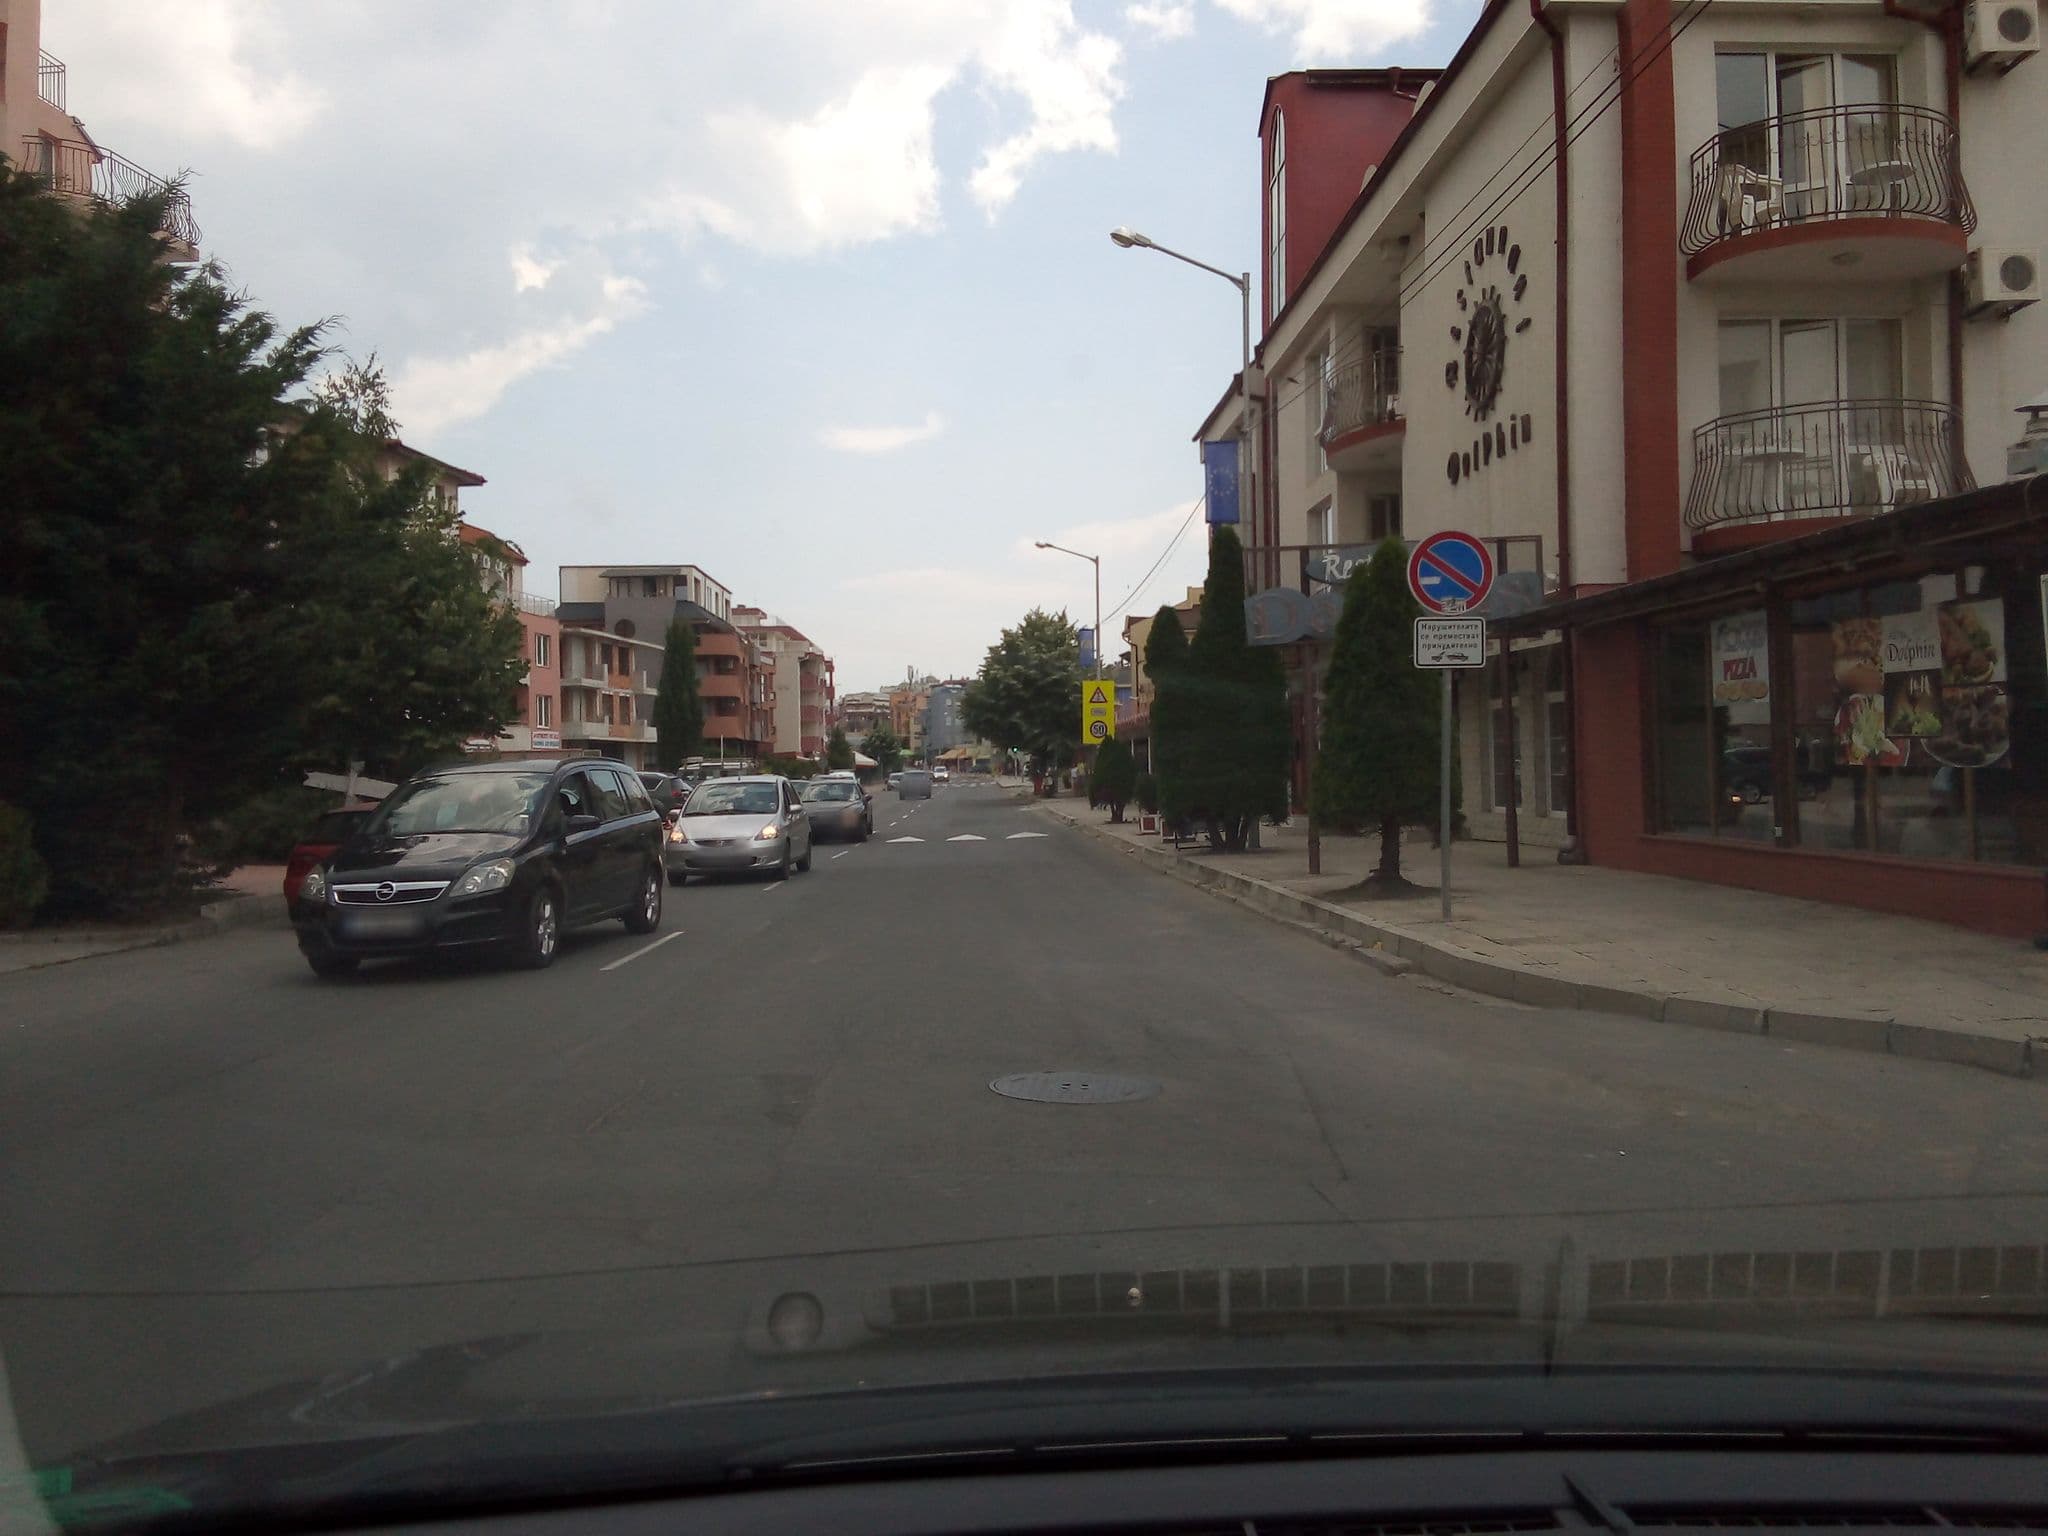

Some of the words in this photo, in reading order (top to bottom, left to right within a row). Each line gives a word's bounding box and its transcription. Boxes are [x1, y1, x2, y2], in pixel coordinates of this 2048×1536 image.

[1887, 640, 1936, 666] Dolphin
[1723, 656, 1758, 680] PIZZA
[1093, 724, 1105, 735] 50
